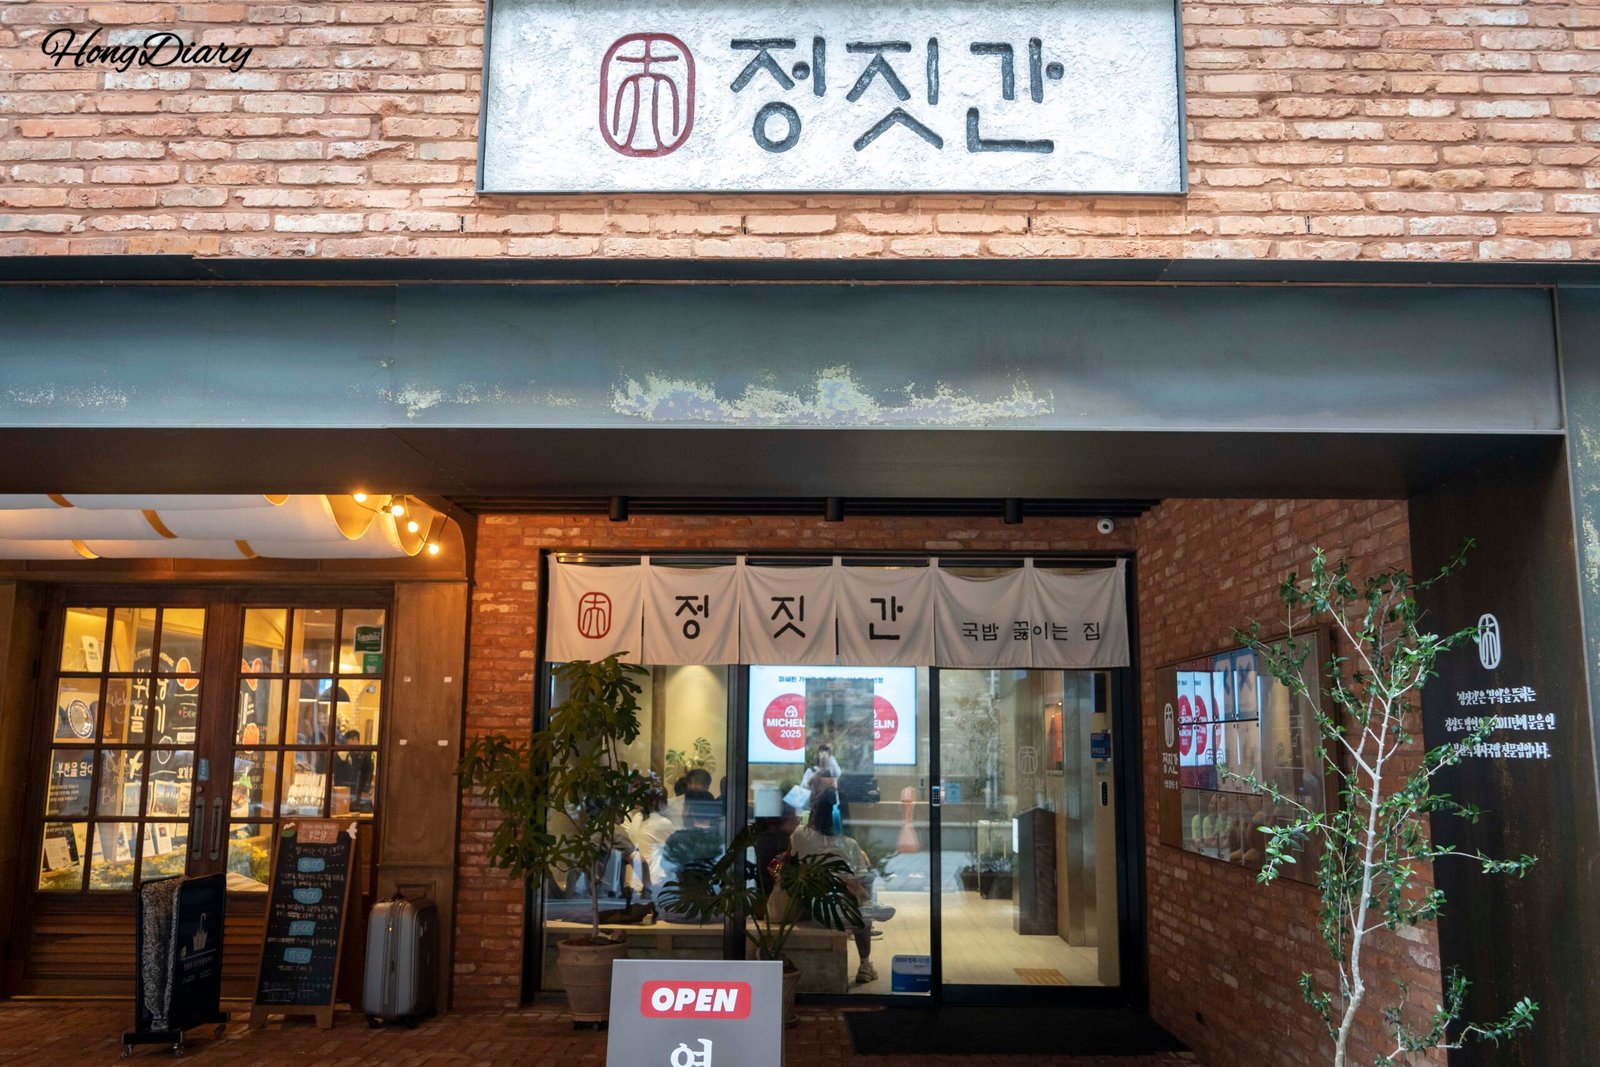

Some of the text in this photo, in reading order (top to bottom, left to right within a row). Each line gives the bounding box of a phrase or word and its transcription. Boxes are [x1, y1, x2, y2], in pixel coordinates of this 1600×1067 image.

[730, 36, 1065, 153] 정짓간
[962, 621, 1101, 641] 국밥 끓이는 집
[1511, 686, 1537, 702] 뜻하는
[1445, 716, 1464, 731] 경상도
[1527, 714, 1545, 730] 문을
[1545, 713, 1556, 729] 연
[780, 729, 801, 738] 2025
[651, 987, 738, 1012] OPEN
